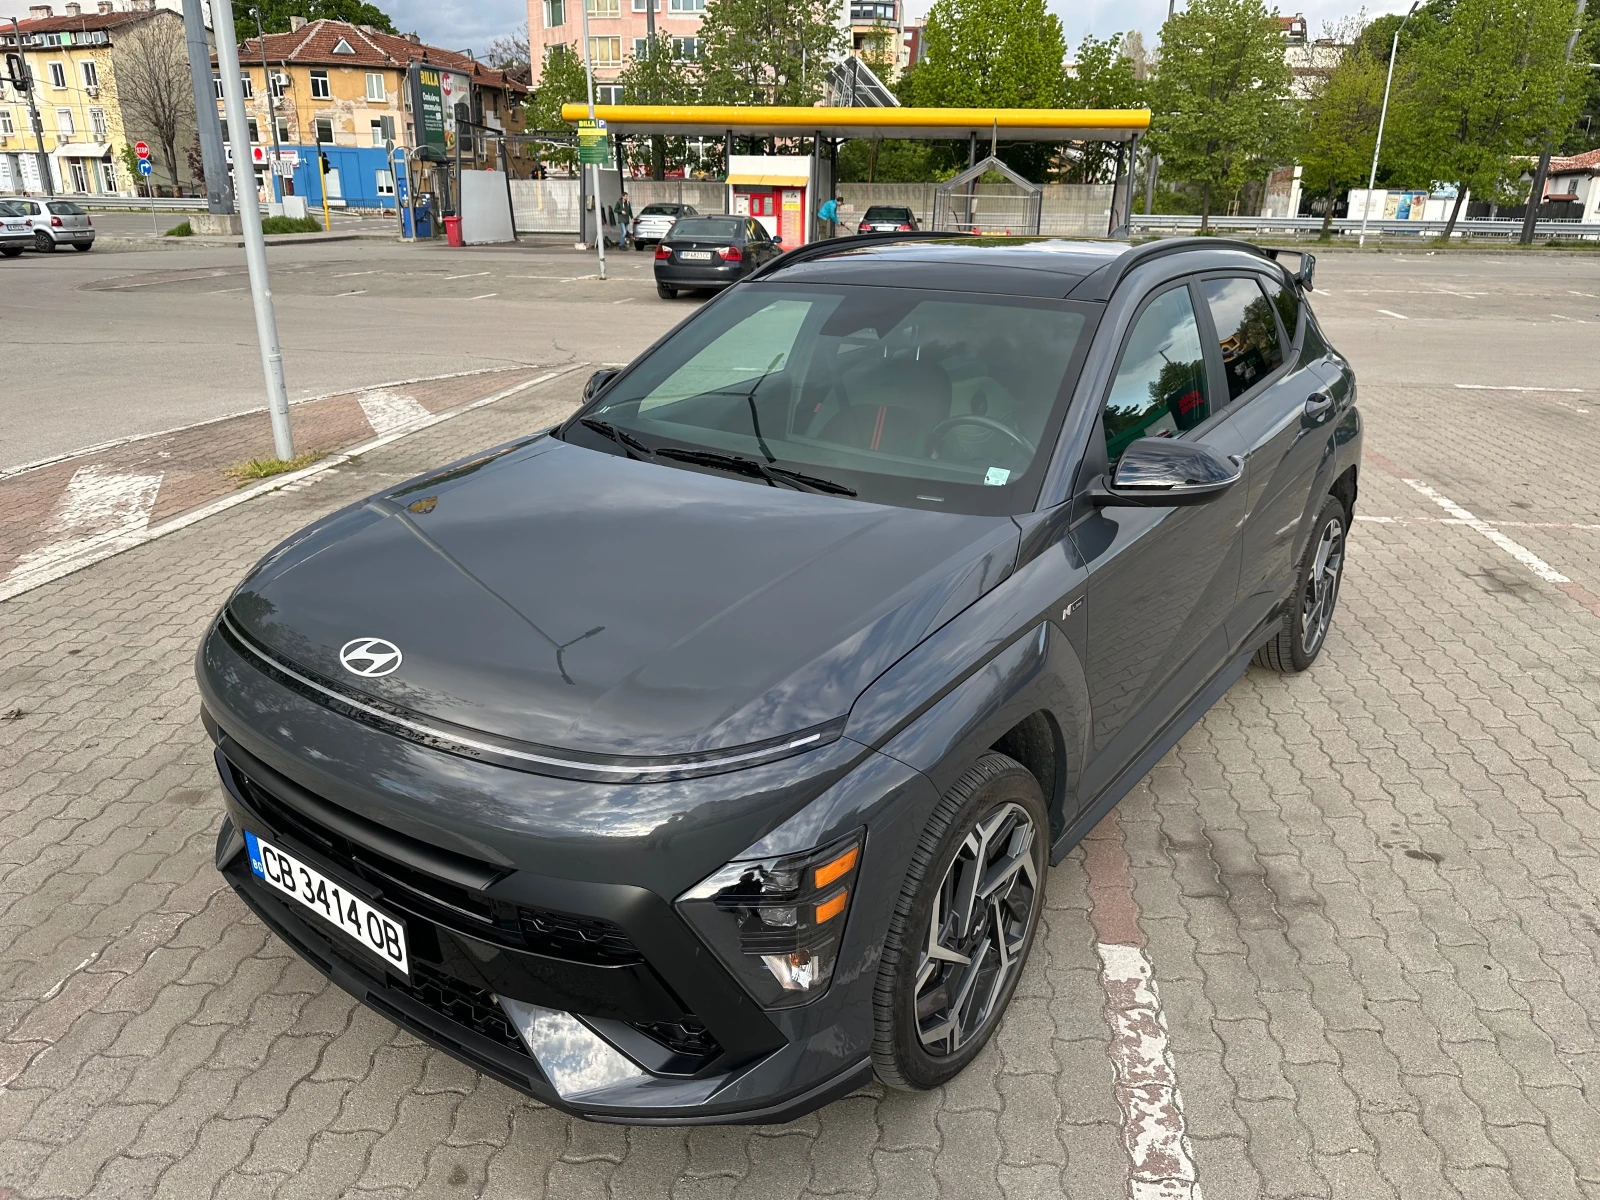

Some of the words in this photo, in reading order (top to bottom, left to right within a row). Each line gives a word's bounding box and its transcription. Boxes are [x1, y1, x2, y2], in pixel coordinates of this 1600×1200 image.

[420, 70, 439, 87] BILLA
[458, 85, 468, 93] BOSCH
[599, 120, 604, 128] P
[252, 859, 263, 872] BG
[262, 846, 296, 892] CB
[300, 867, 363, 937] 3414
[366, 911, 402, 963] OB
